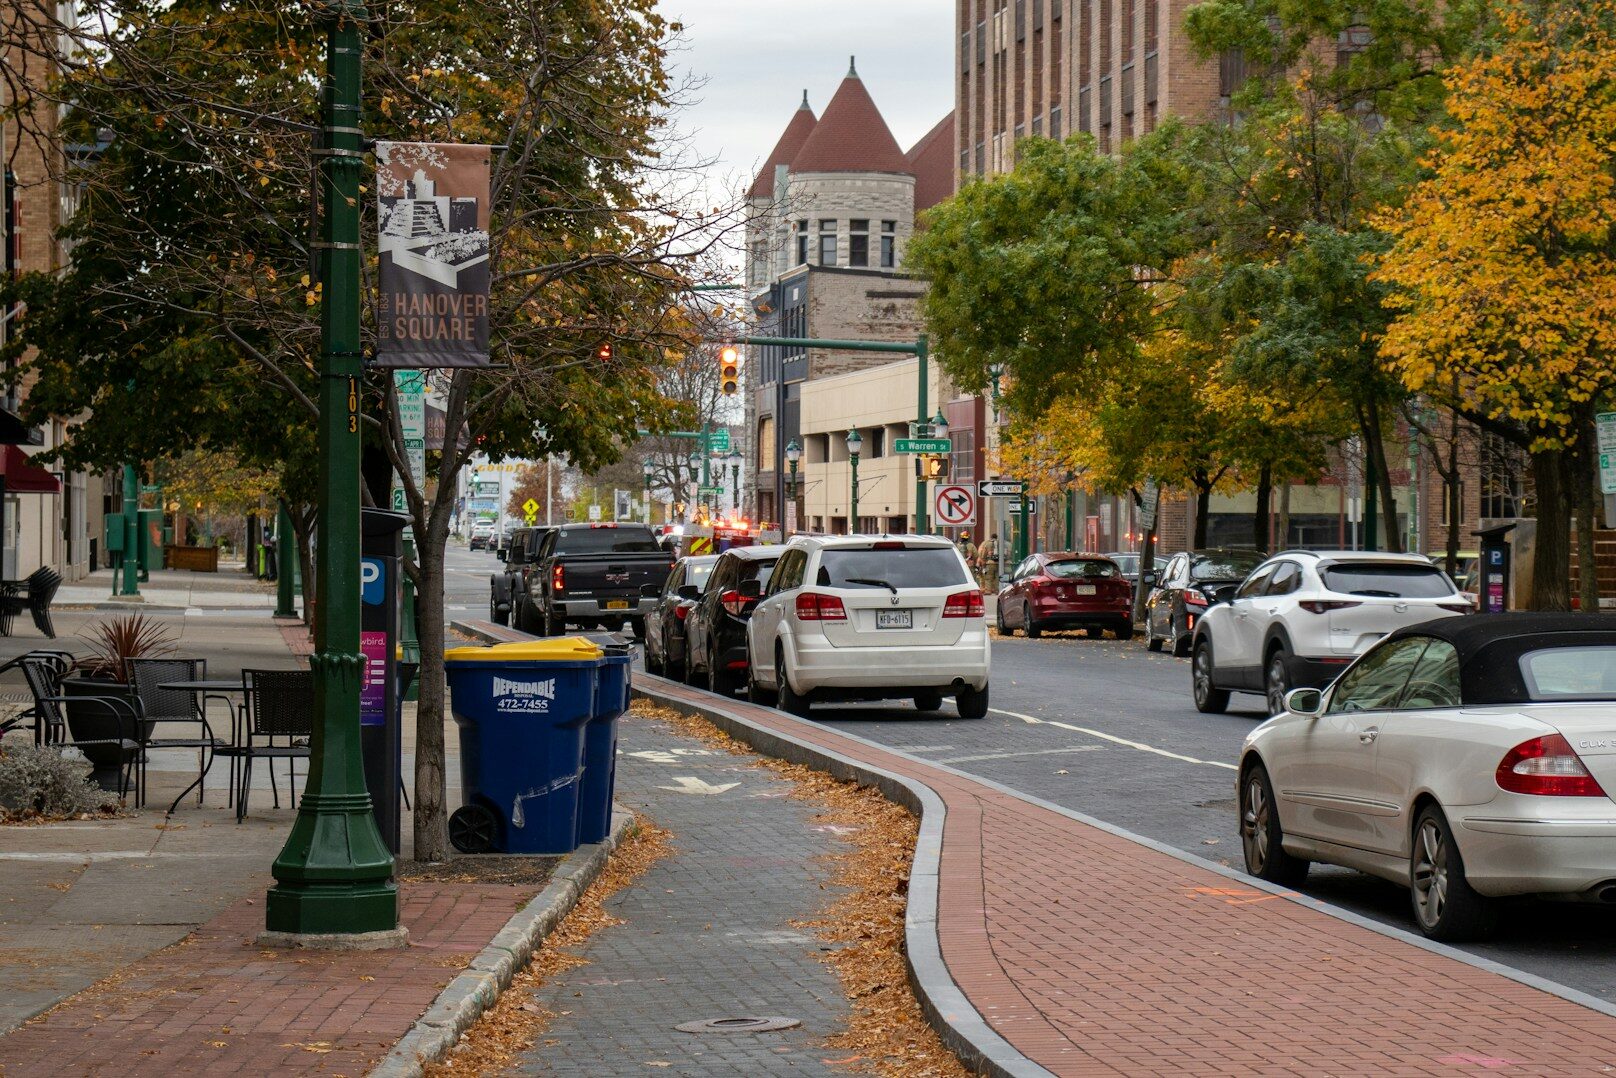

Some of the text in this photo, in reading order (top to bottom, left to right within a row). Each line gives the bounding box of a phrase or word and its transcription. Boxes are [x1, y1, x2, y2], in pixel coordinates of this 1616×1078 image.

[380, 292, 389, 313] 1834
[395, 292, 486, 317] HANOVER
[395, 316, 475, 341] SQUARE
[349, 378, 357, 433] 103
[399, 404, 421, 412] ARKING
[428, 427, 446, 439] SQU
[908, 441, 937, 450] Warren
[395, 493, 402, 507] 2
[1491, 550, 1502, 563] P
[361, 562, 380, 595] P
[360, 637, 385, 646] wbird.
[493, 676, 556, 700] DEPENDABLE
[498, 699, 548, 708] 472-7455
[1580, 740, 1606, 748] CLK
